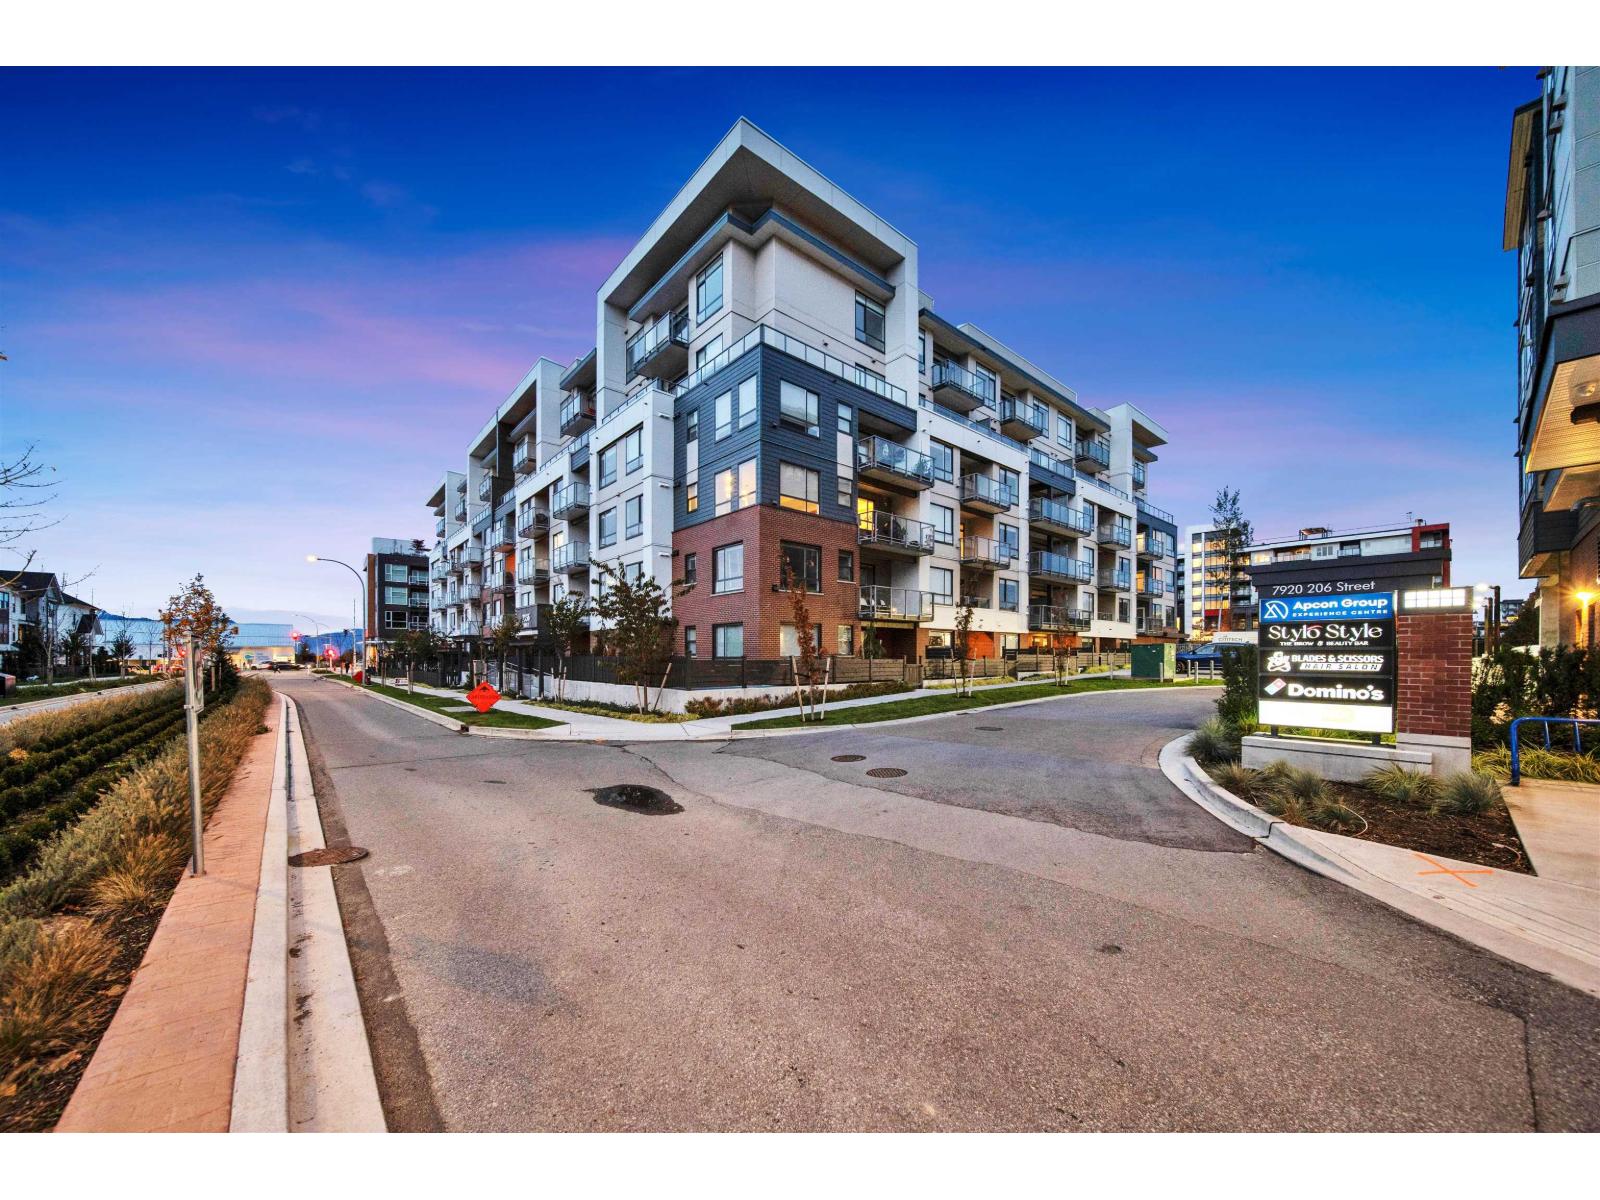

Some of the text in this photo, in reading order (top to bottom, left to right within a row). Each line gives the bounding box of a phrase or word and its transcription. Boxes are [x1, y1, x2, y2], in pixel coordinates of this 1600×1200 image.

[1272, 580, 1376, 596] 7920 206 Street
[1292, 598, 1388, 611] Apcon Group
[1324, 622, 1383, 641] Style
[1291, 654, 1384, 663] BLADES & SCISSORS
[1287, 683, 1384, 700] Domino's
